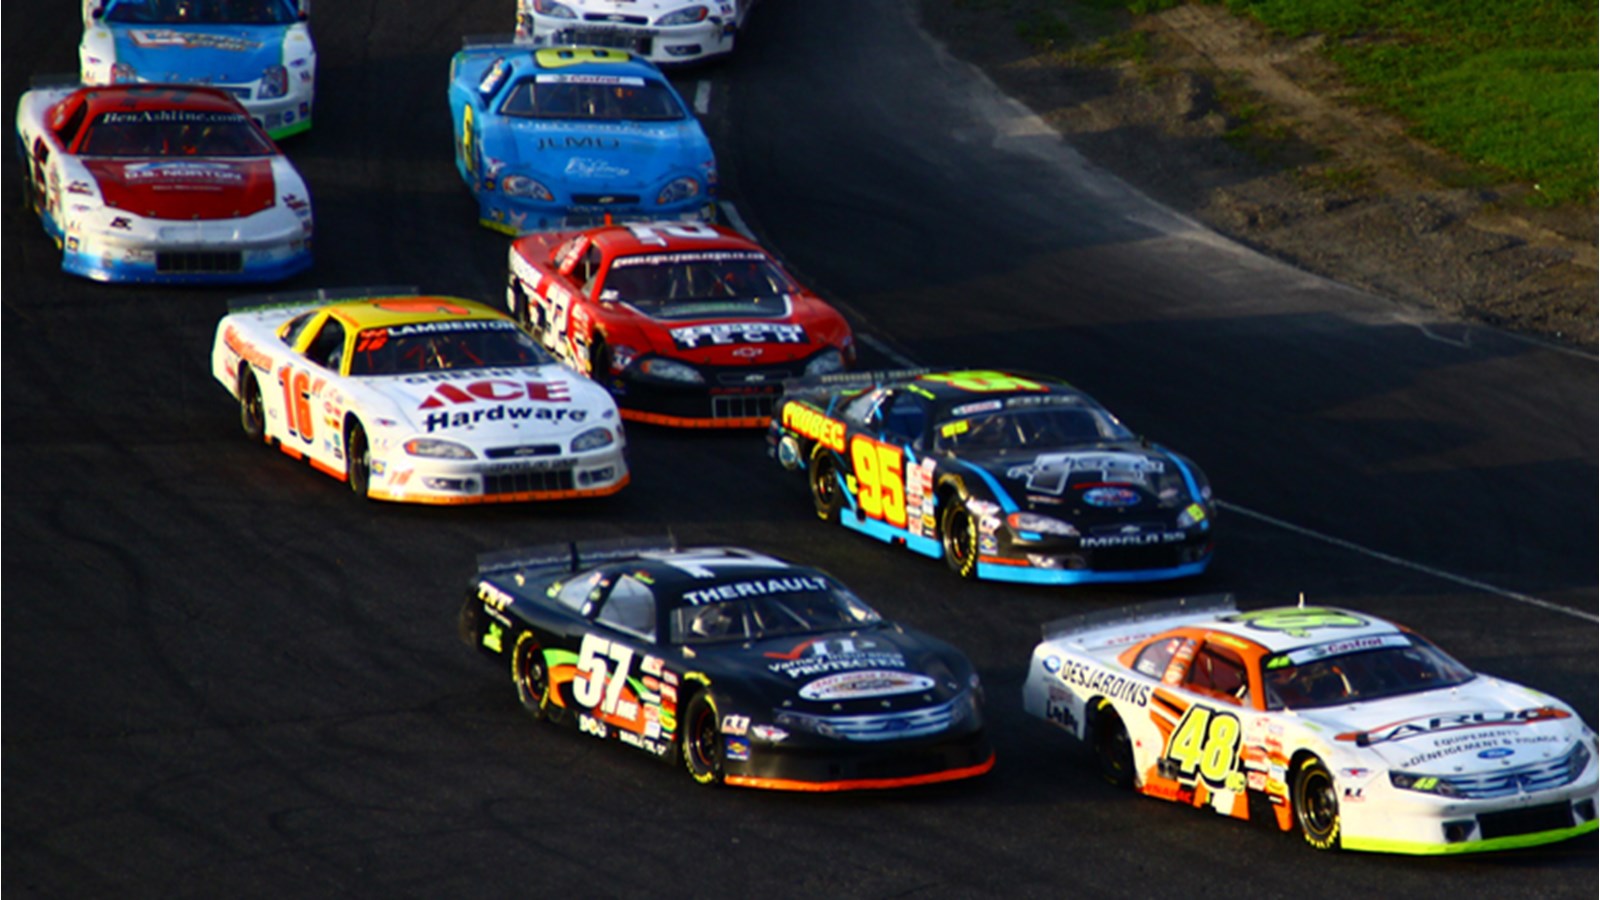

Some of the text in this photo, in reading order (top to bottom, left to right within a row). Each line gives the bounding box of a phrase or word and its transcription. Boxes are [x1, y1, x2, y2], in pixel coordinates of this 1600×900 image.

[680, 331, 801, 348] TECH
[277, 362, 314, 444] 16
[418, 379, 572, 410] ACE
[425, 405, 588, 433] Hardware
[781, 400, 847, 453] PROBEC
[850, 433, 907, 529] 95
[1080, 536, 1158, 547] IMPALA
[683, 577, 828, 605] THERIAULT
[1327, 637, 1383, 653] Castrol
[572, 632, 634, 715] 57
[787, 658, 906, 679] PROTECTED
[1061, 659, 1150, 708] DESJARDINS
[1167, 703, 1242, 790] 48
